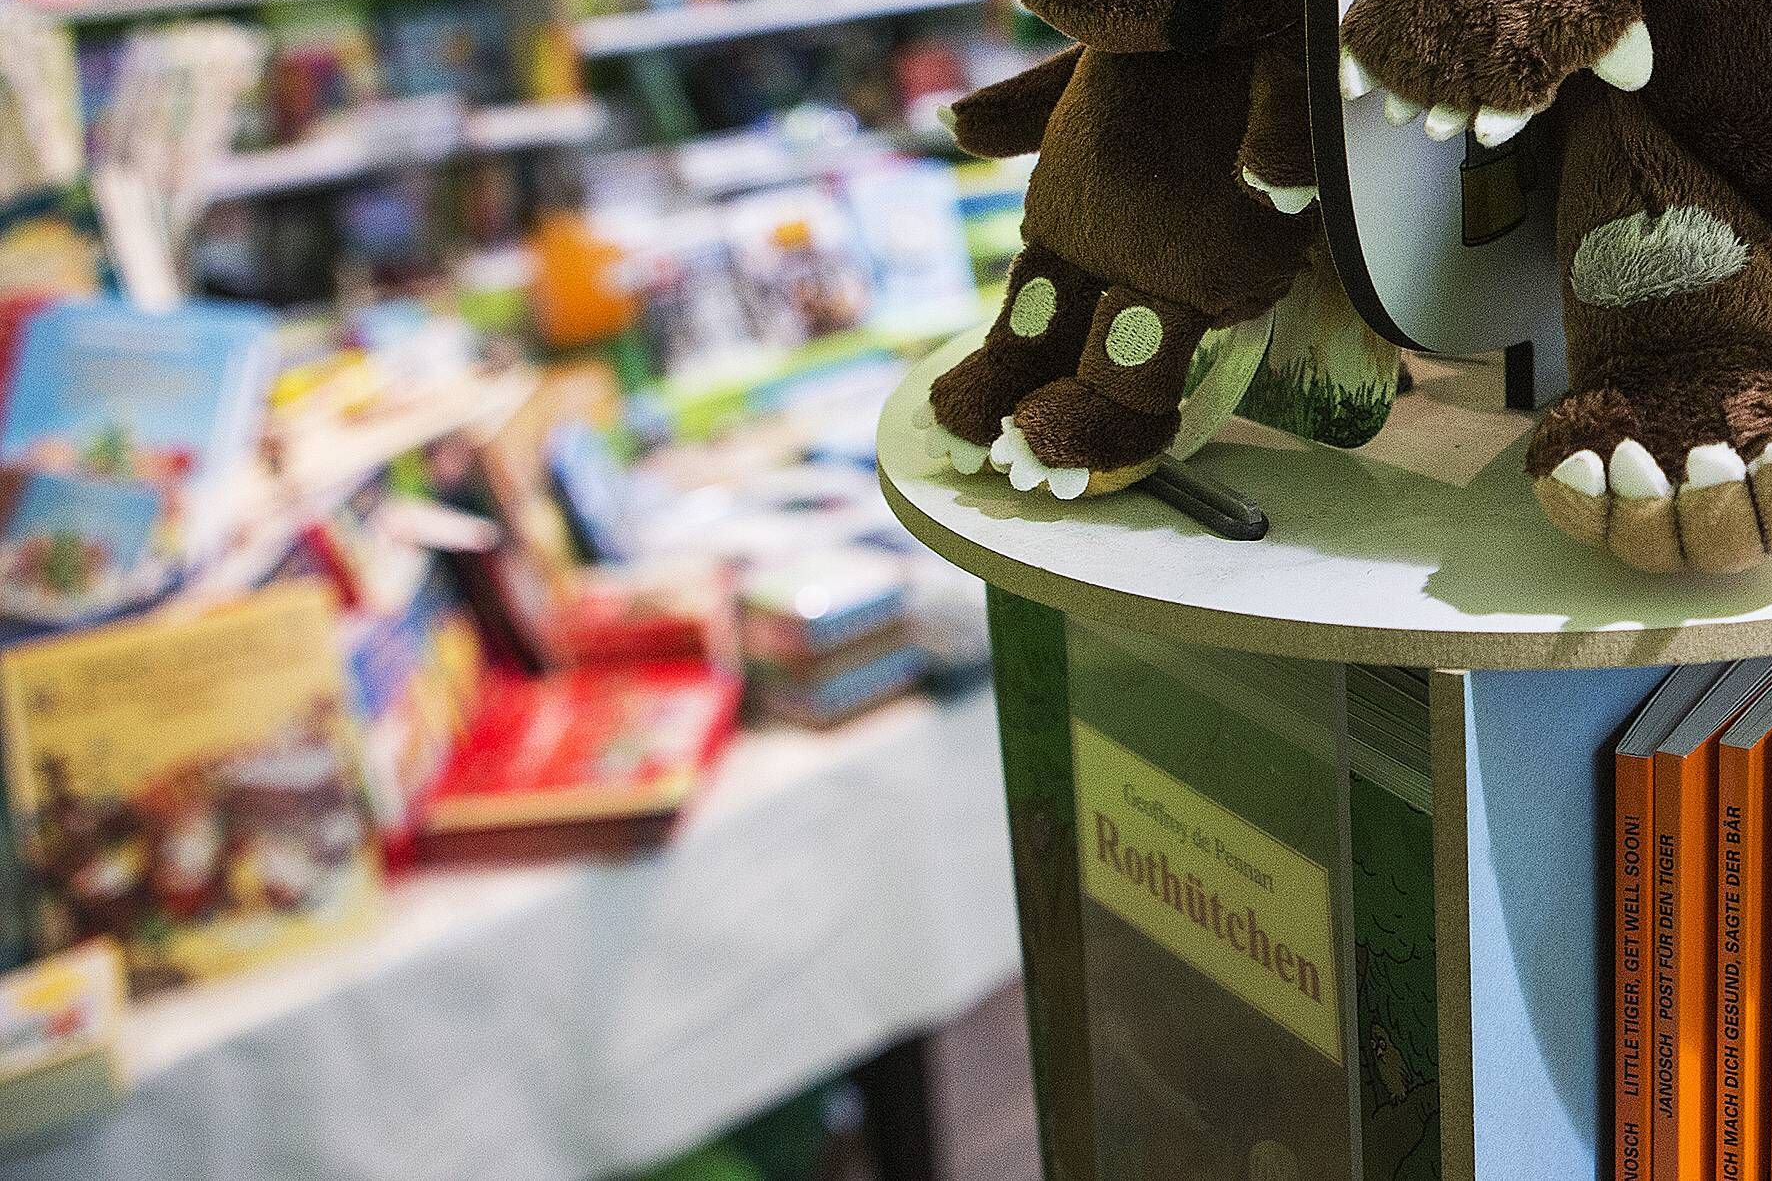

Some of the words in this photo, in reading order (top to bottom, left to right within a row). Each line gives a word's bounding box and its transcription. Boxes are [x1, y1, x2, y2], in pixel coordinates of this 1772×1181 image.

[1624, 815, 1640, 877] SOON!
[1724, 806, 1741, 844] BÄR
[1660, 834, 1674, 886] TIGER
[1726, 850, 1741, 887] DER
[1093, 811, 1322, 1005] Rothütchen
[1624, 884, 1640, 931] WELL
[1660, 892, 1674, 930] DEN
[1725, 892, 1740, 954] SAGTE
[1624, 935, 1640, 972] GET
[1657, 933, 1674, 969] FÜR
[1624, 978, 1641, 1035] TIGER,
[1659, 973, 1674, 1020] POST
[1725, 961, 1741, 1040] GESUND,
[1624, 1039, 1640, 1096] LITTLE
[1659, 1033, 1673, 1118] JANOSCH
[1725, 1045, 1739, 1089] DICH
[1724, 1093, 1738, 1147] MACH
[1624, 1122, 1639, 1181] NOSCH
